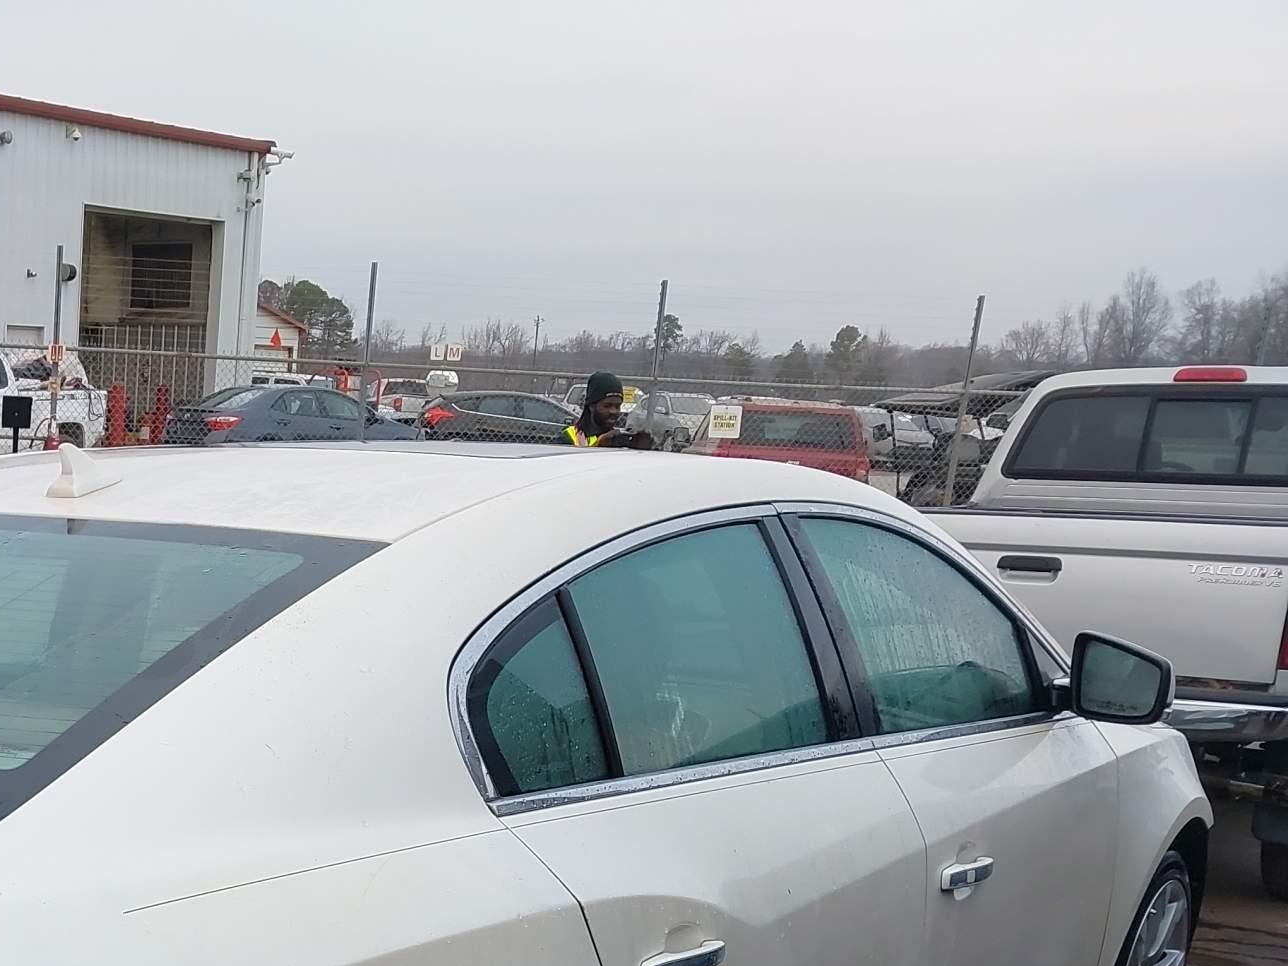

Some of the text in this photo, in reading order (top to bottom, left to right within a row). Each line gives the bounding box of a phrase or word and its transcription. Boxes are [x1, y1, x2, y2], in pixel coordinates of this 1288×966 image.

[448, 347, 461, 359] M
[714, 421, 736, 430] STATION
[1187, 563, 1285, 579] TACOMA
